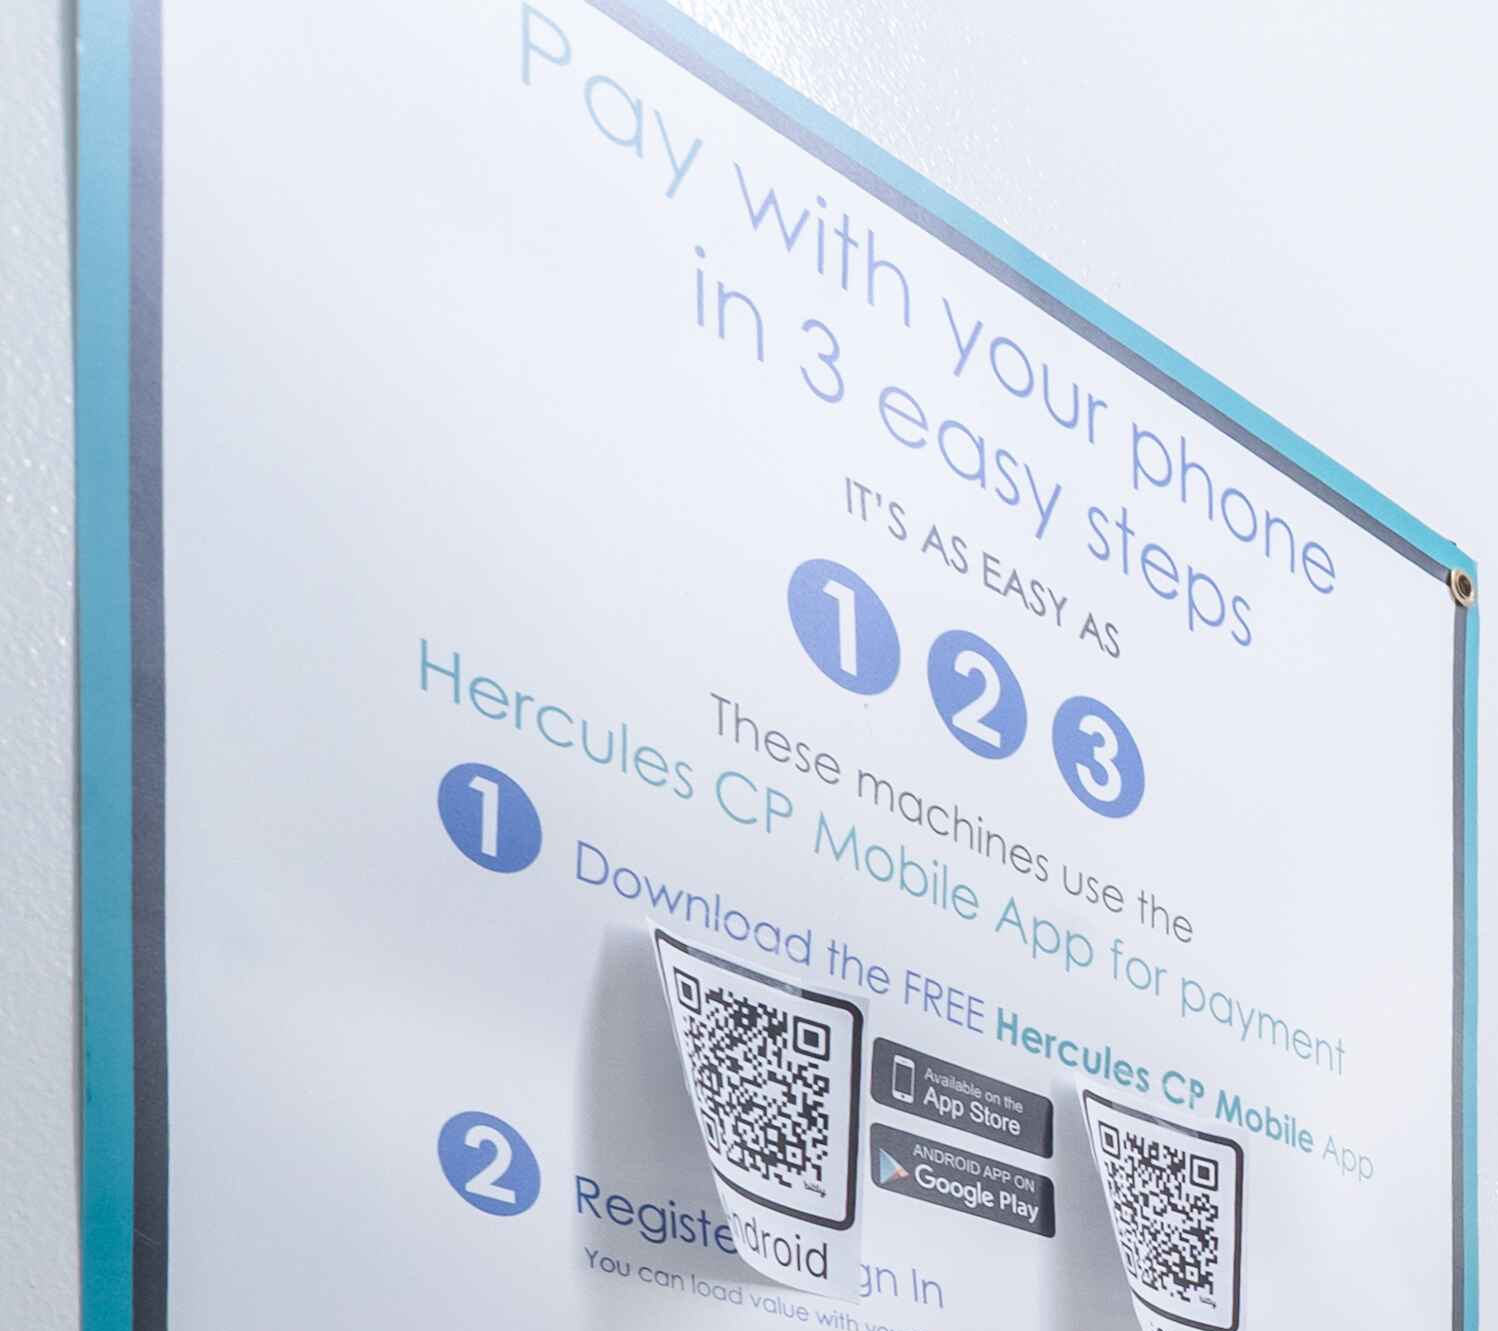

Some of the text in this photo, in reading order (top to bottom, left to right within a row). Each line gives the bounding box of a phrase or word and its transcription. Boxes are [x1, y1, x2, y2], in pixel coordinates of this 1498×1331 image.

[521, 2, 1337, 595] Pay with your phone
[693, 244, 1252, 647] in 3 easy steps
[844, 477, 1121, 659] IT'S AS EASY AS
[822, 580, 1122, 802] 1 2 3
[420, 638, 1346, 1076] Hercules CP Mobile App for payment
[710, 692, 1193, 944] These machines use the
[469, 774, 1375, 1183] 1 Download the FREE Hercules CP Mobile App
[914, 1143, 1036, 1192] ANDROID APP ON
[923, 1066, 1024, 1114] Available on the
[923, 1087, 1021, 1136] App Store
[464, 1125, 516, 1202] 2
[576, 1175, 737, 1254] Registe
[912, 1267, 944, 1309] In
[584, 1247, 630, 1278] You
[638, 1260, 684, 1289] can
[691, 1273, 744, 1306] load
[750, 1294, 809, 1323] value
[731, 1212, 828, 1280] ndroid
[915, 1166, 1039, 1224] Google Play
